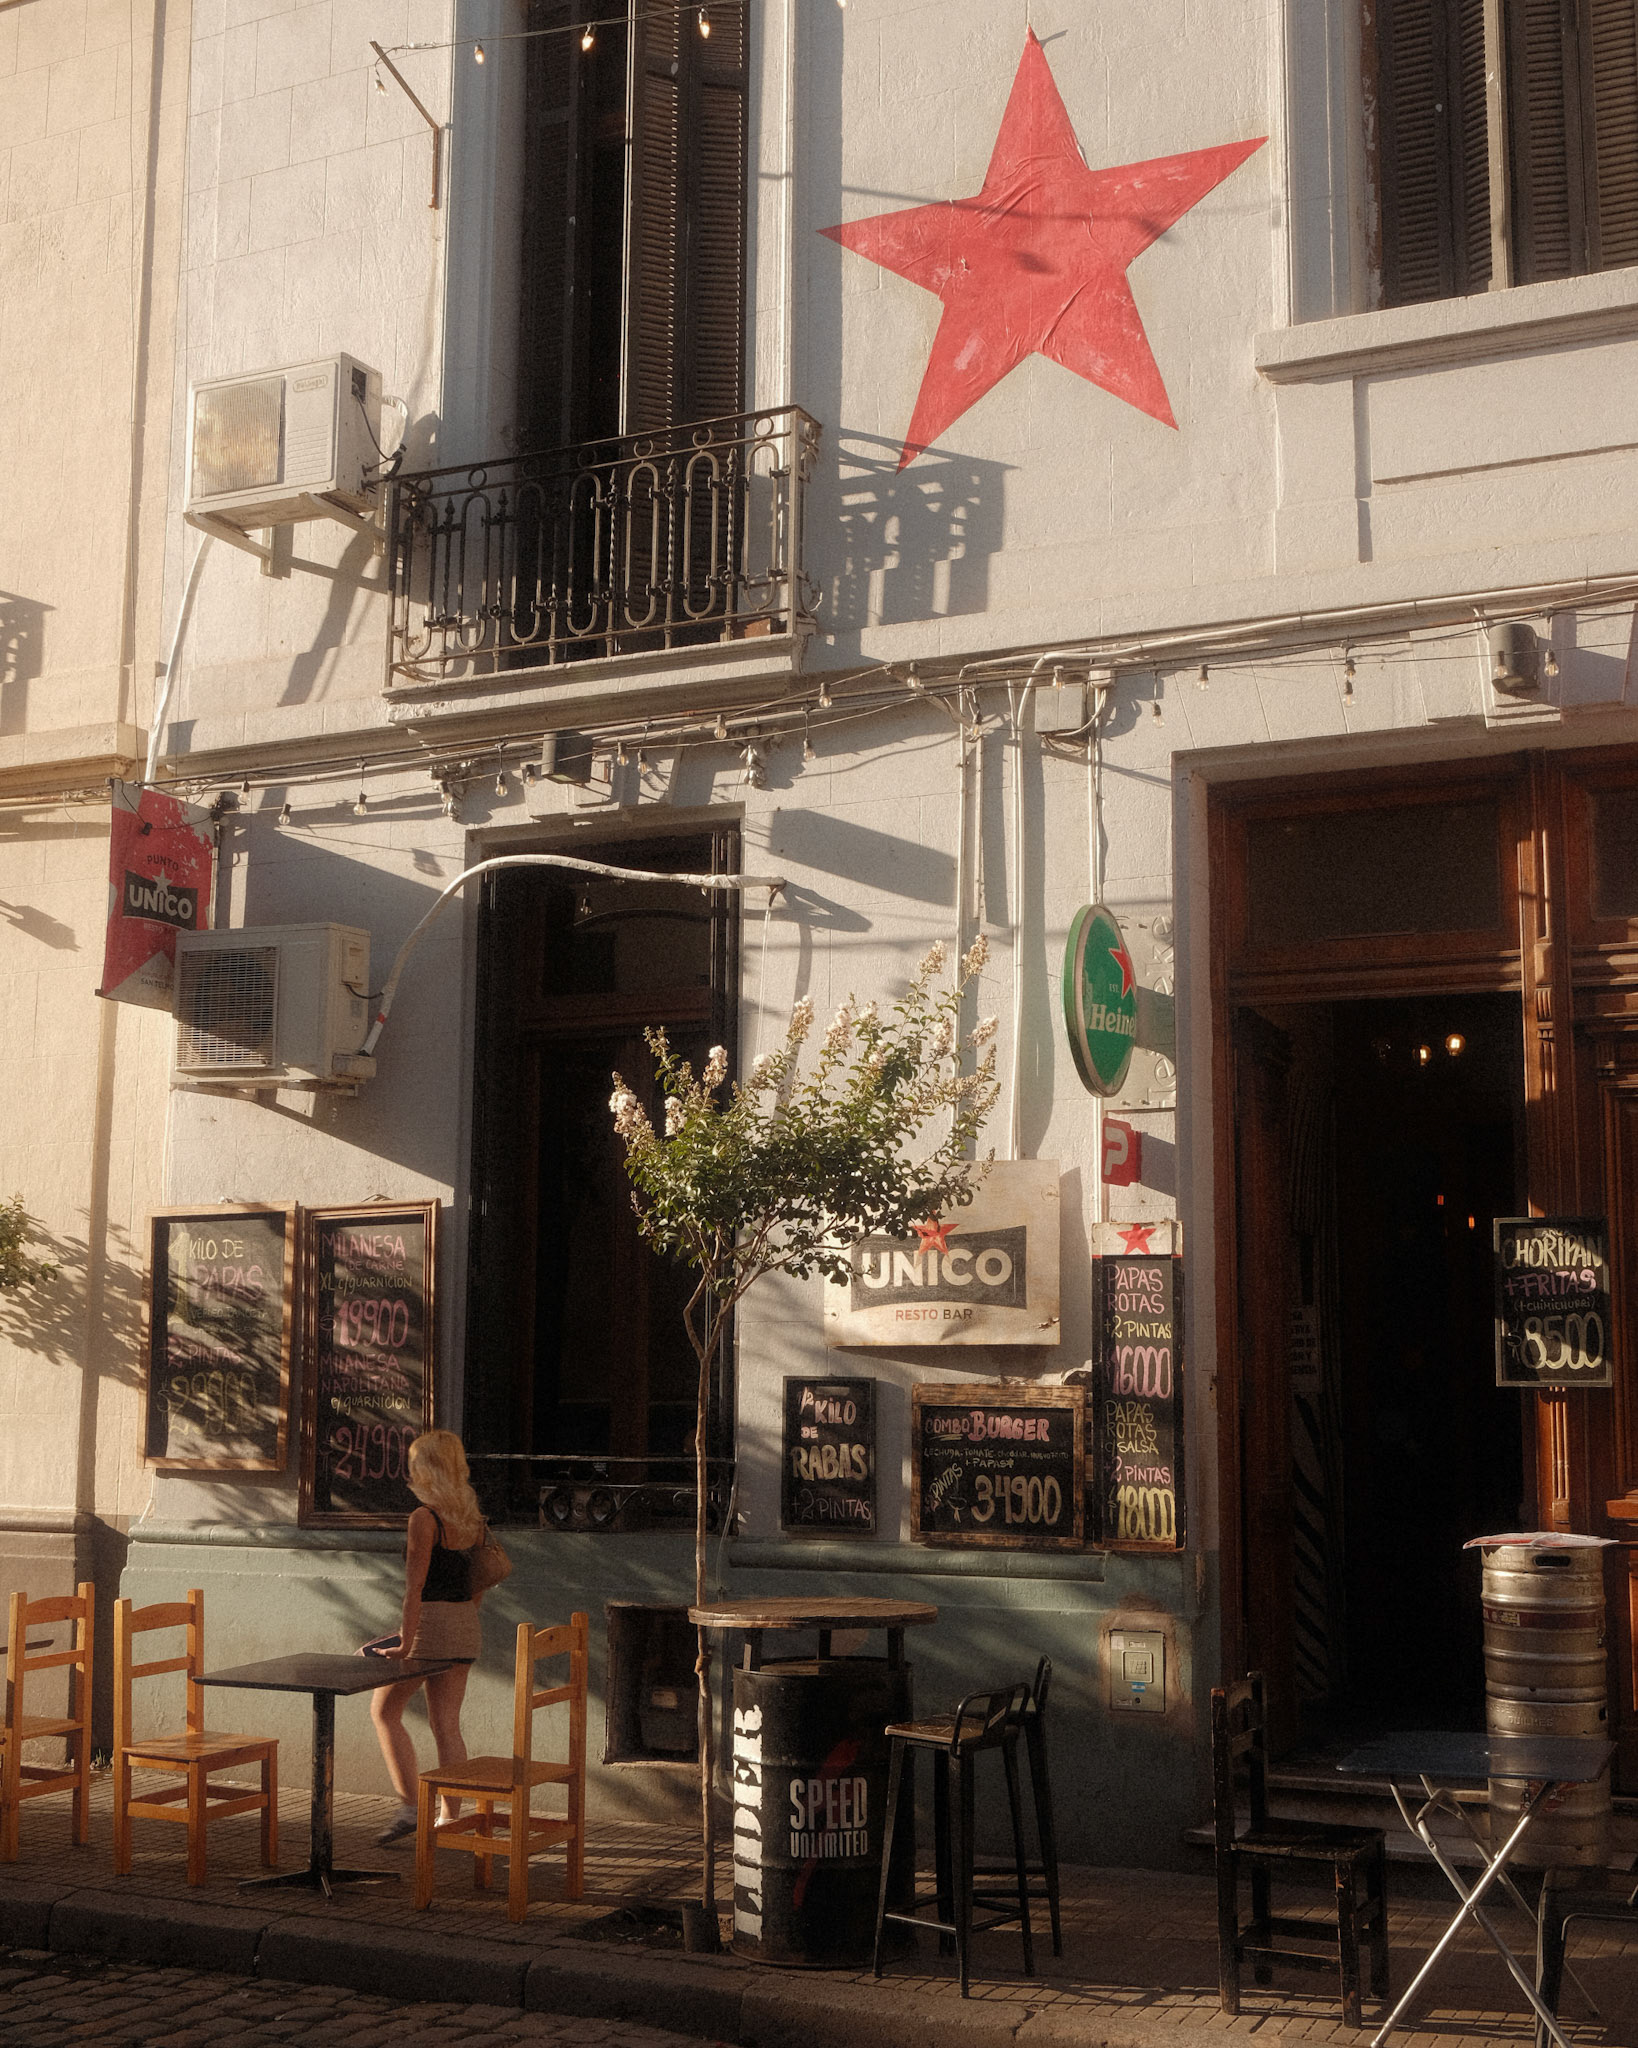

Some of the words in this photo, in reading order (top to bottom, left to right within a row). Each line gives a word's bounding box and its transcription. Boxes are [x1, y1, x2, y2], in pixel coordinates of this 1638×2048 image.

[147, 854, 179, 872] PUNTO
[129, 883, 192, 920] UNICO
[221, 1238, 244, 1259] DE
[1502, 1235, 1603, 1269] CHORIPAN
[862, 1248, 1013, 1289] UNICO
[1104, 1264, 1164, 1292] PAPAS
[320, 1272, 336, 1291] XL
[895, 1309, 938, 1322] RESTO
[942, 1308, 973, 1321] BAR
[1104, 1292, 1166, 1315] ROTAS
[1123, 1320, 1172, 1339] PINTAS
[1104, 1400, 1154, 1423] PAPAS
[800, 1426, 818, 1439] DE
[925, 1417, 969, 1434] COMBO
[967, 1410, 1050, 1442] BURGER
[1106, 1422, 1157, 1442] ROTAS
[790, 1443, 868, 1481] RABAS
[1124, 1464, 1173, 1485] PINTAS
[816, 1498, 872, 1521] PINTAS
[789, 1777, 868, 1831] SPEED
[790, 1830, 868, 1859] UNLIMITED
